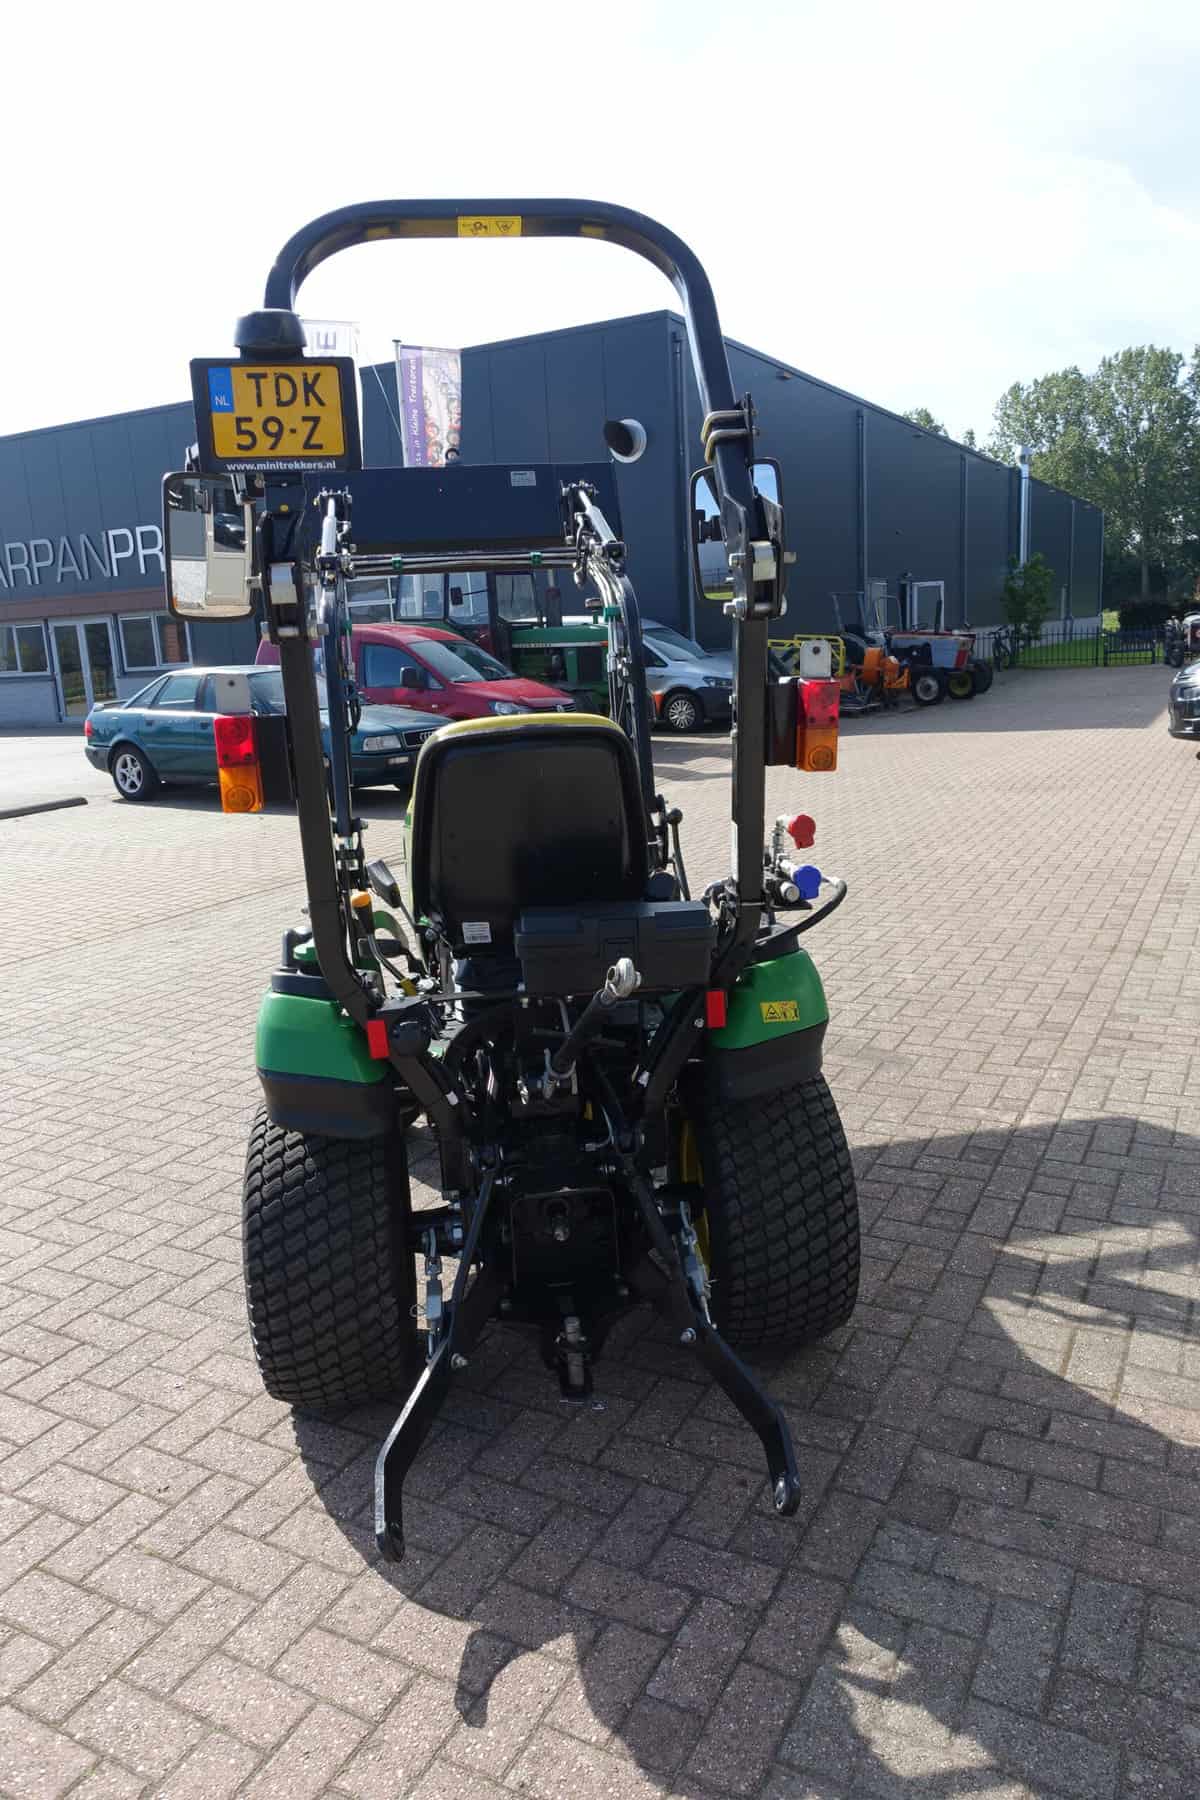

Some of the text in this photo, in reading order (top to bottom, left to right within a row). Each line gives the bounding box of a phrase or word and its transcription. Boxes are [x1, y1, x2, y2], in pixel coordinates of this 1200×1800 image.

[214, 395, 230, 407] NL
[246, 371, 326, 408] TDK
[235, 415, 324, 452] 59-Z
[226, 460, 336, 471] www.minitrekkers.nl
